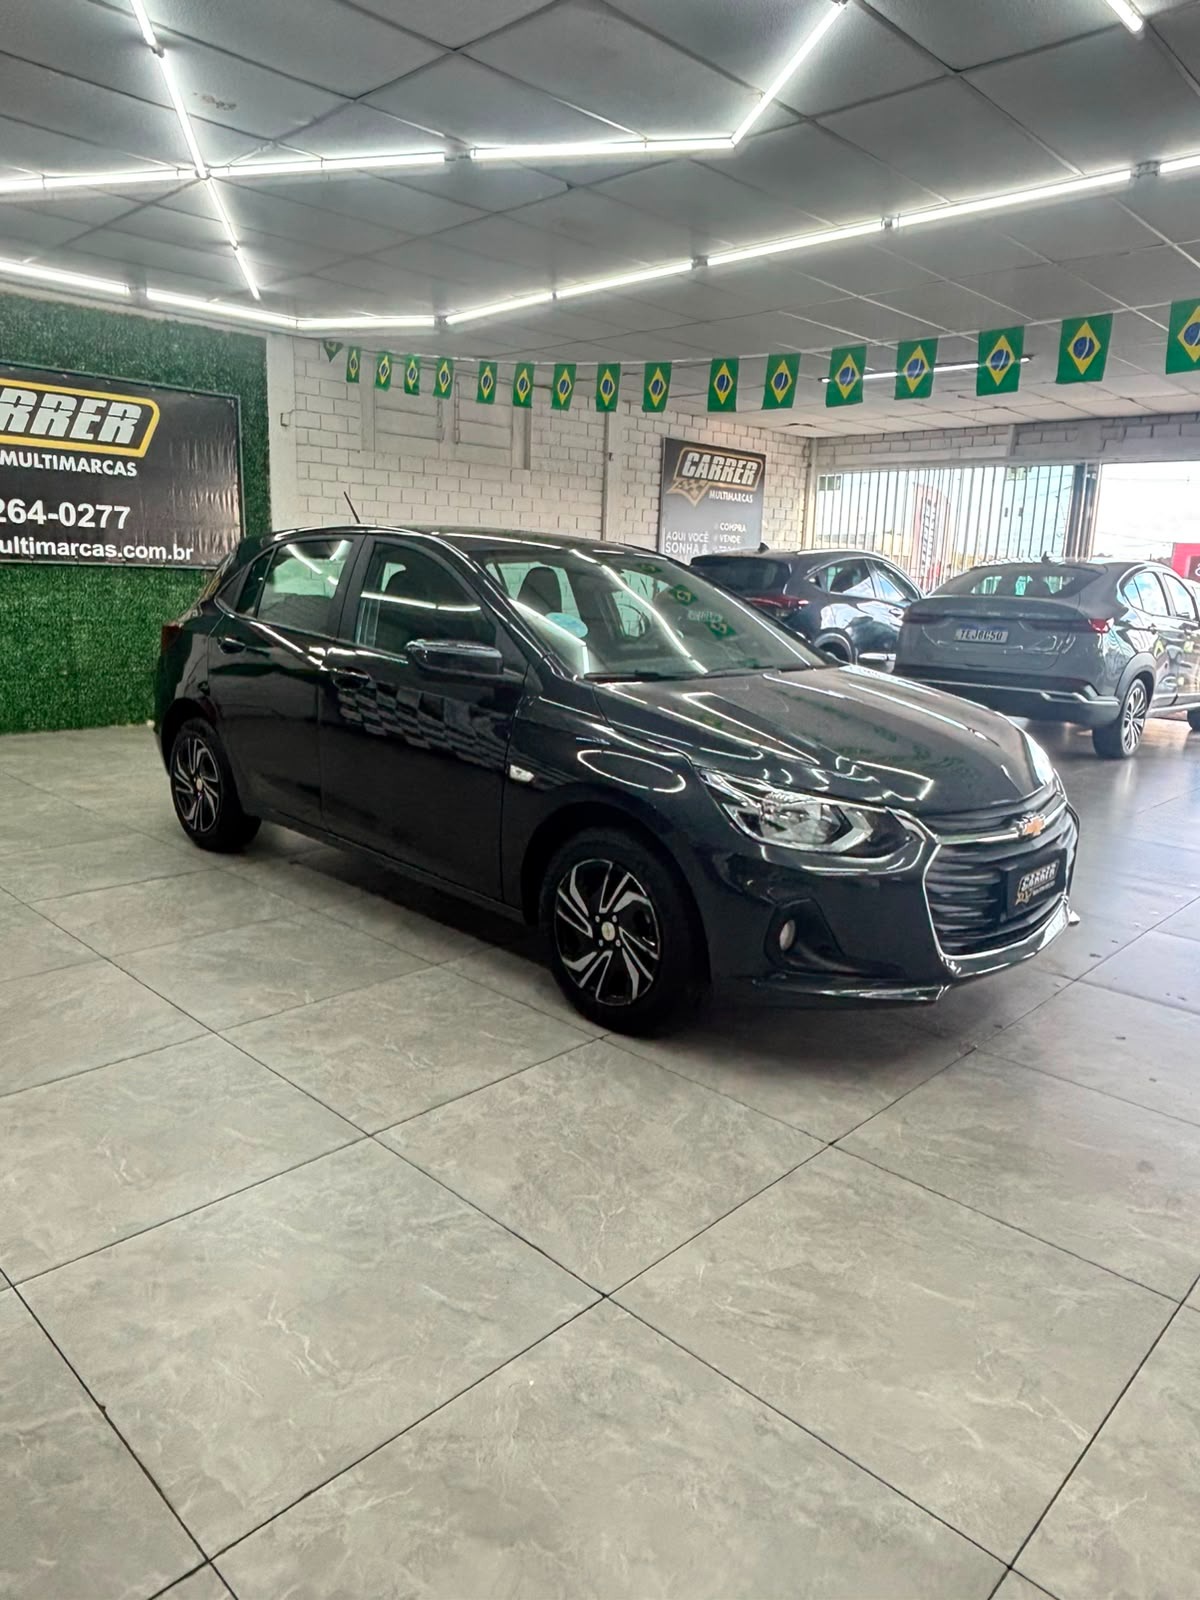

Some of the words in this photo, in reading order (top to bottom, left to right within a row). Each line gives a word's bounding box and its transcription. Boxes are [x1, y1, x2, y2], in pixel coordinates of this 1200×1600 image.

[0, 449, 138, 477] MULTIMARCAS
[682, 452, 758, 486] CARRER
[709, 489, 753, 504] MULTIMARCAS
[720, 522, 746, 533] COMPRA
[666, 531, 686, 542] AQUI
[688, 531, 709, 543] VOCÊ
[720, 534, 741, 545] VENDE
[665, 541, 700, 555] SONHA
